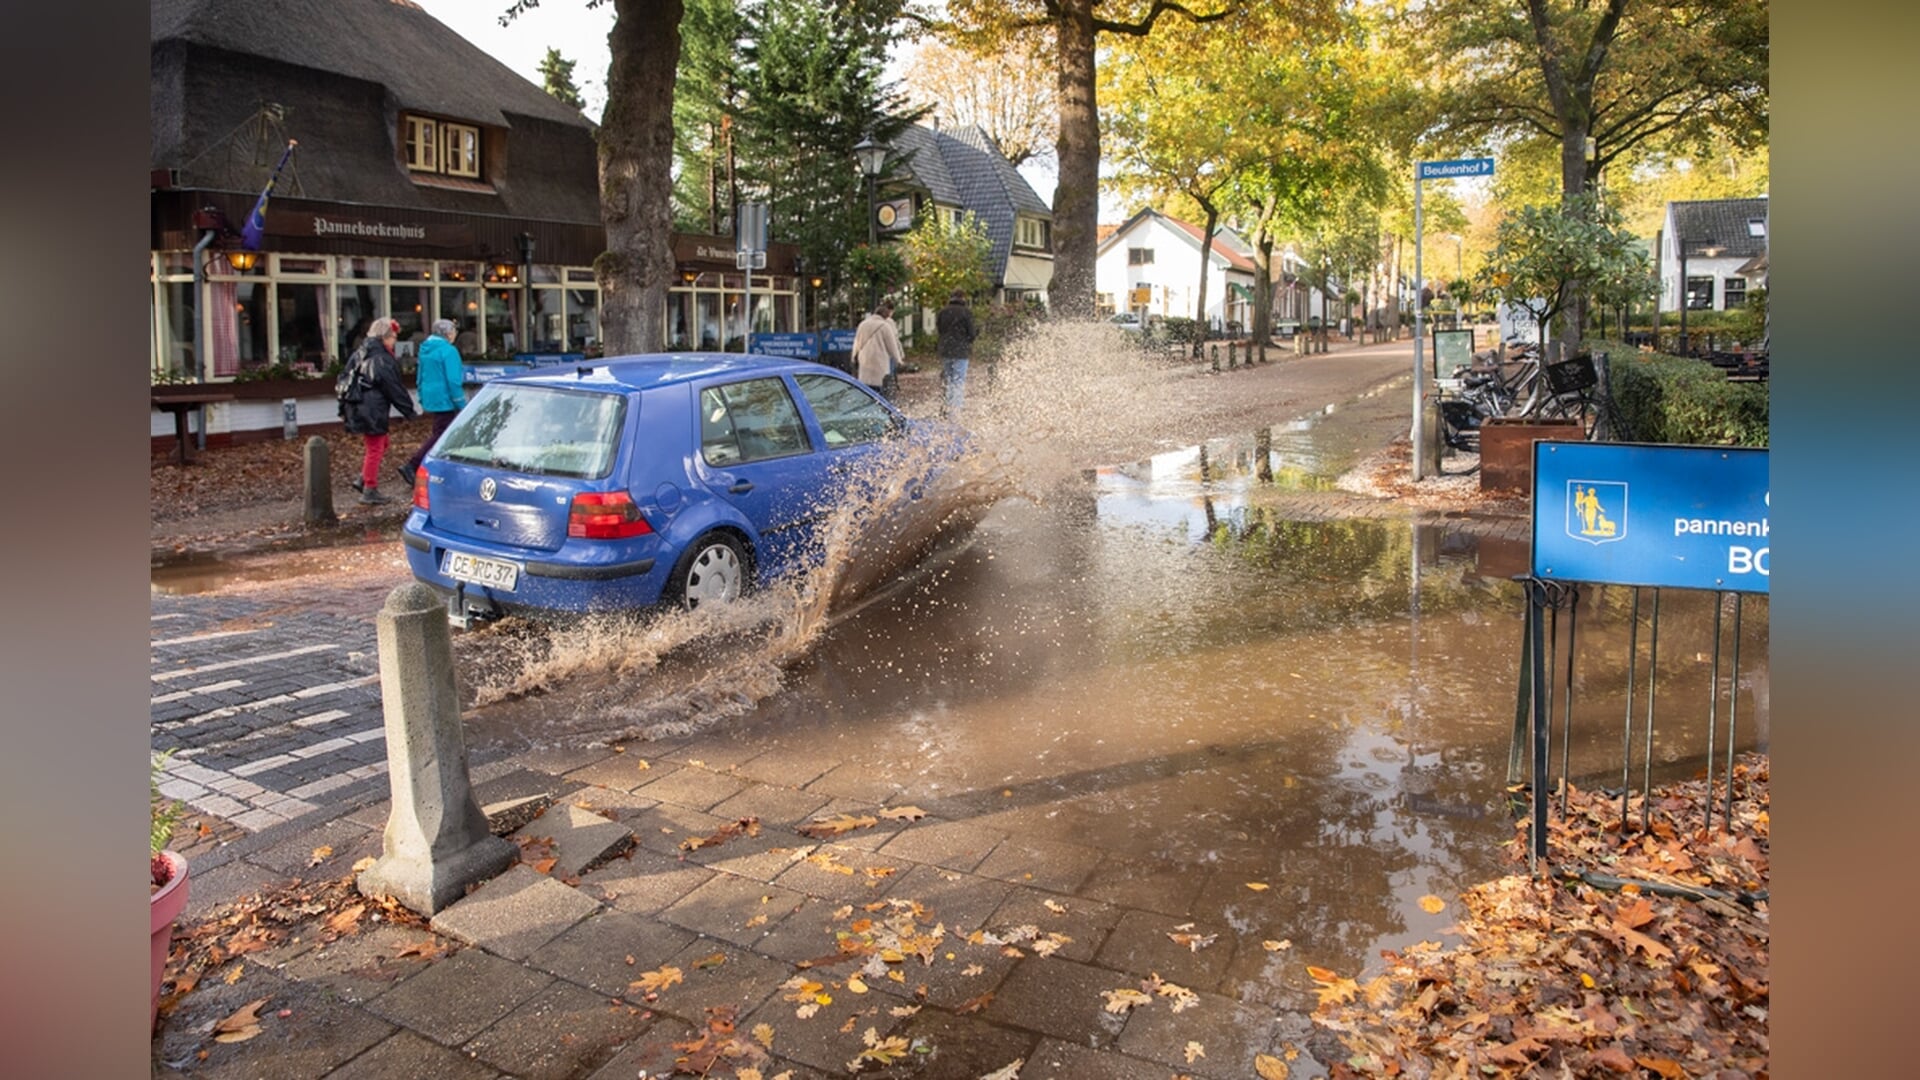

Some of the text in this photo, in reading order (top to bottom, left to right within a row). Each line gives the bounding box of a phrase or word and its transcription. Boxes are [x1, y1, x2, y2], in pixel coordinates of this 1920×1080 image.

[1424, 163, 1480, 176] Beukenhof
[313, 217, 425, 239] Pannekoekenhuis
[453, 556, 512, 583] CE RC 37
